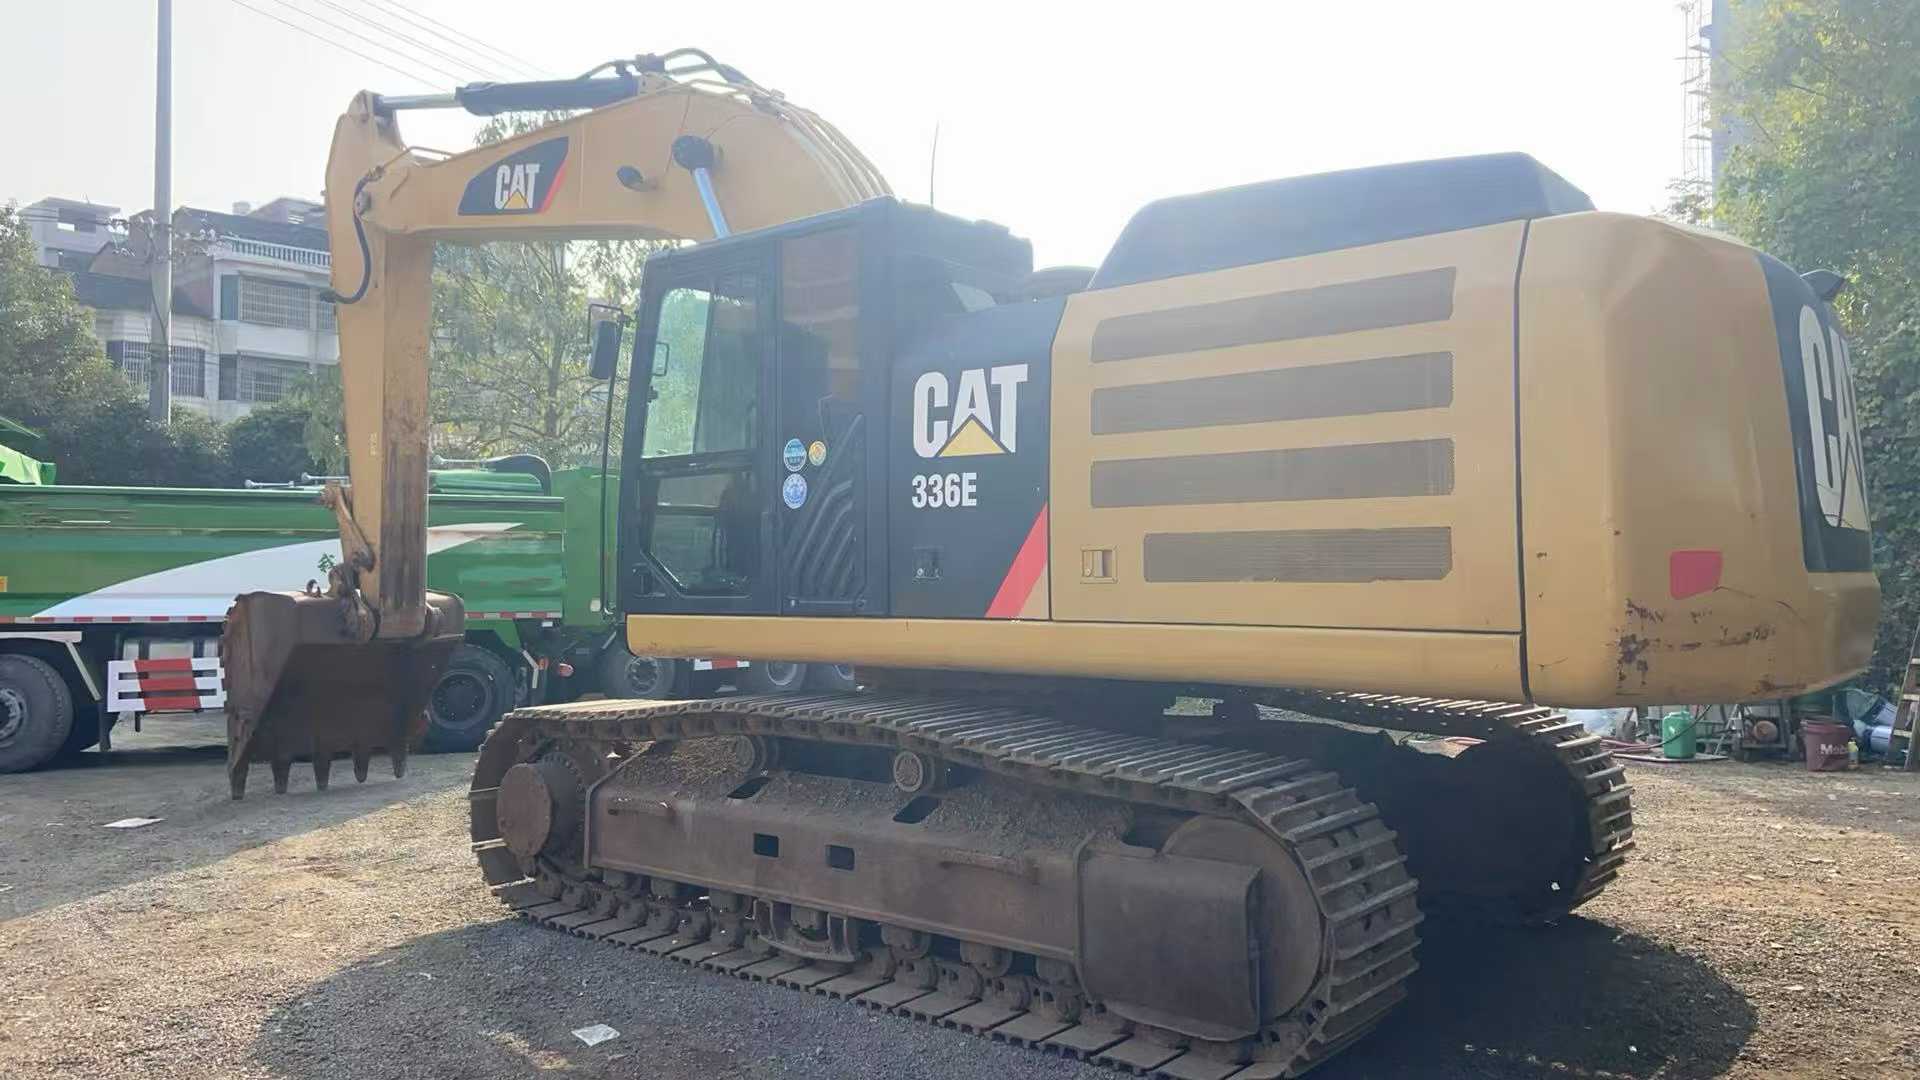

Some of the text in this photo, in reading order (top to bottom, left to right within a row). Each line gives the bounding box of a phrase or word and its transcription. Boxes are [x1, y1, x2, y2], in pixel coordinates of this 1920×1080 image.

[494, 163, 540, 209] CAT
[912, 364, 1028, 458] CAT
[1799, 304, 1870, 529] CA
[912, 472, 977, 508] 336E
